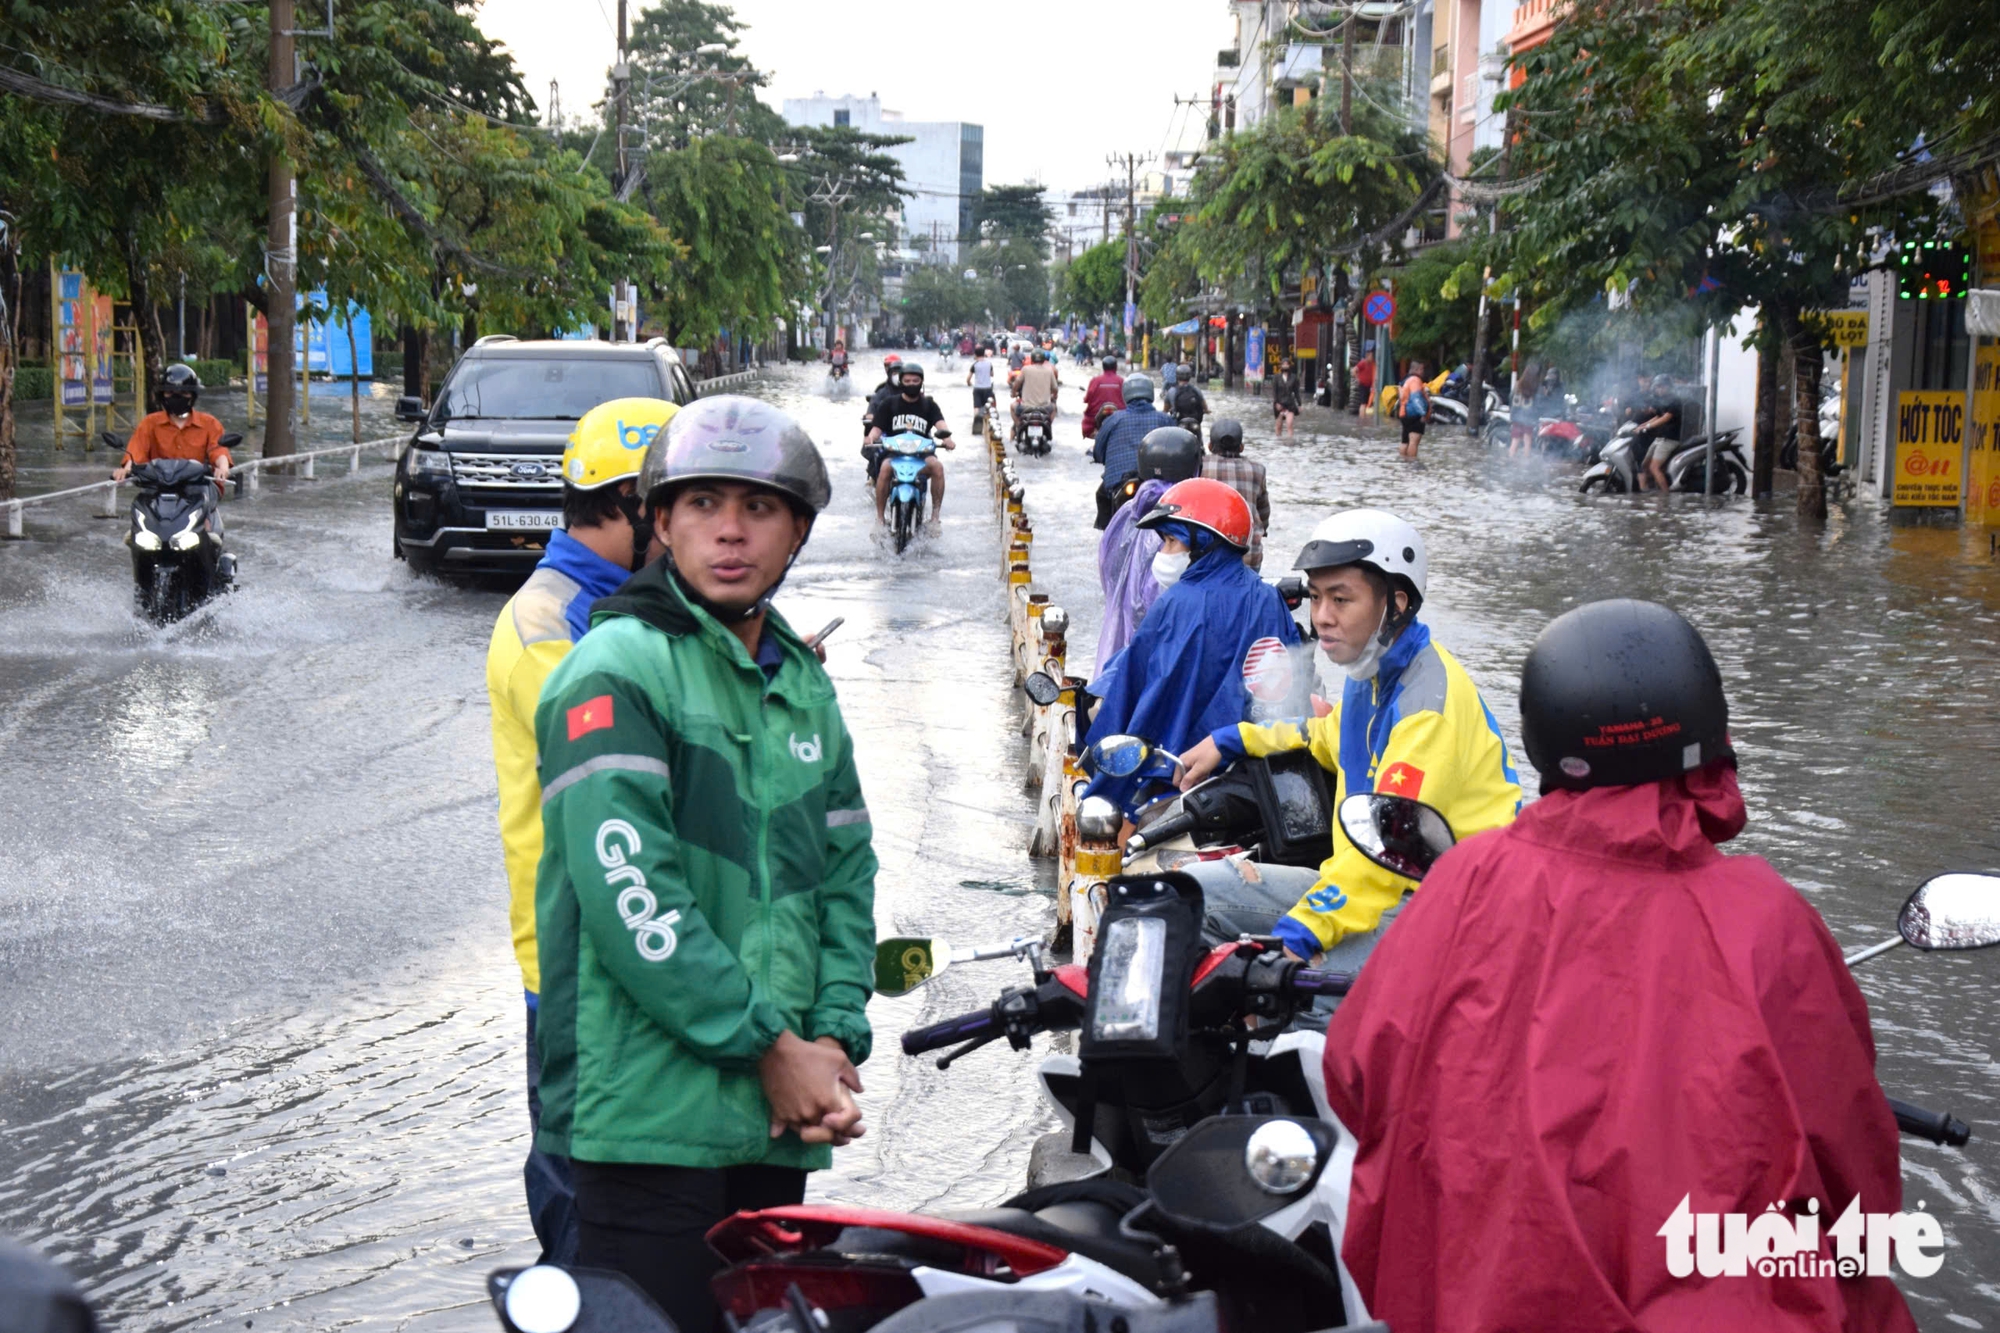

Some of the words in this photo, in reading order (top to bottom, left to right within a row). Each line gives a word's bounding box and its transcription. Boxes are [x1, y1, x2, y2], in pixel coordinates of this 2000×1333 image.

[1899, 395, 1930, 444] HỚT
[1934, 395, 1962, 444] TÓC
[617, 420, 661, 450] be
[517, 465, 537, 474] Ford
[1598, 721, 1645, 734] YAMAHA
[595, 818, 681, 962] Grab
